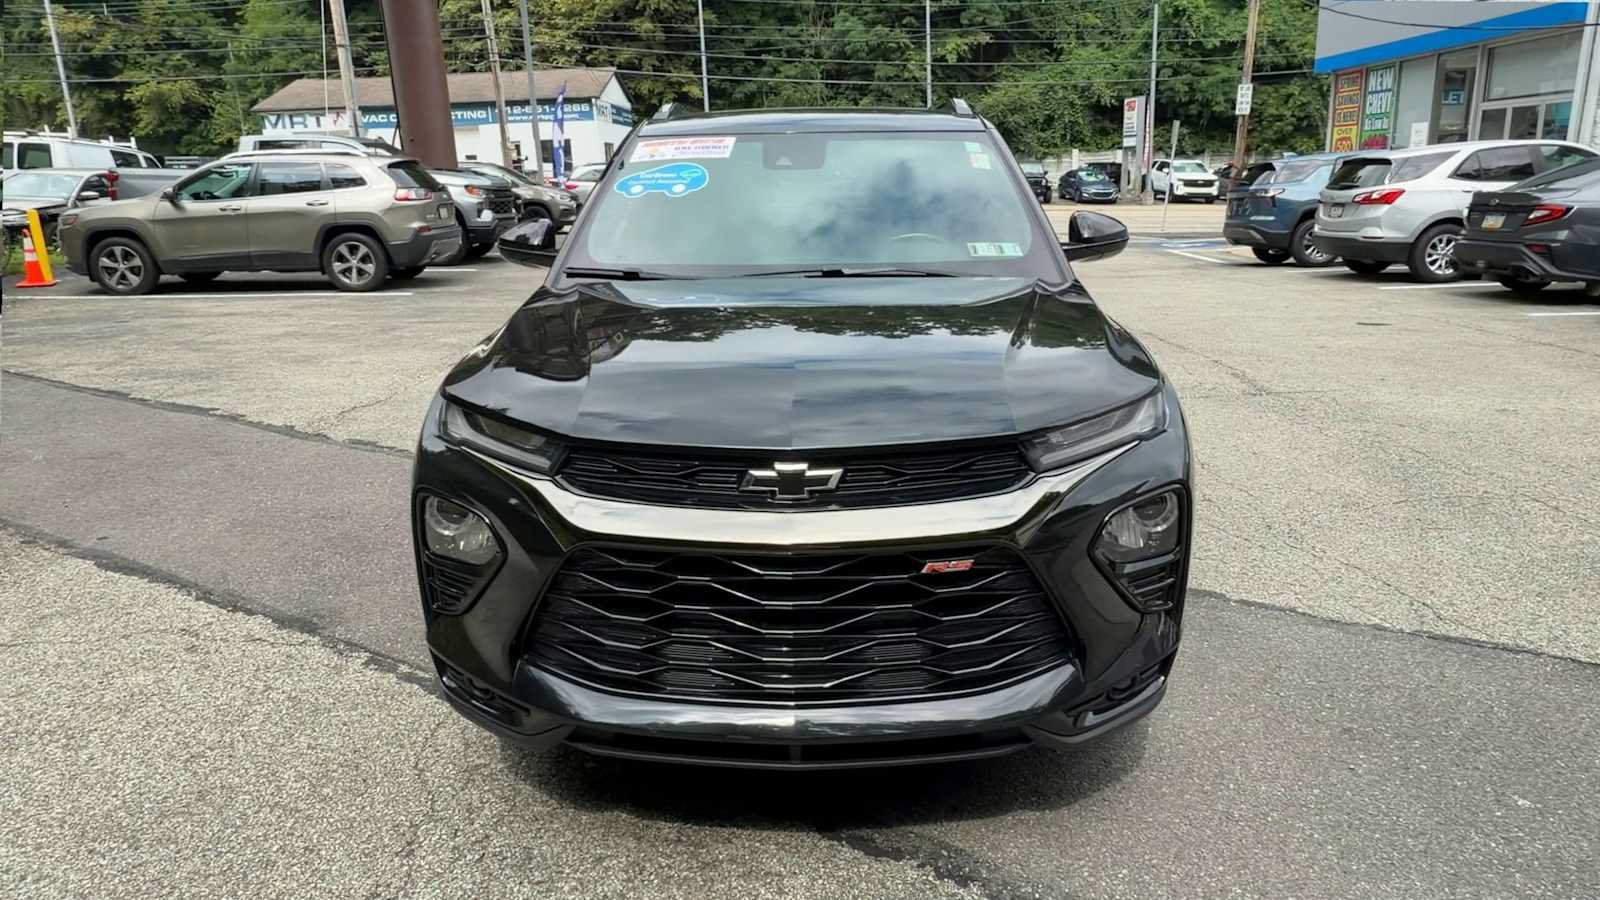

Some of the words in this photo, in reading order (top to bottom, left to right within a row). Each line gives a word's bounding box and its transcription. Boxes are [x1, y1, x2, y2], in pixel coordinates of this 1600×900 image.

[1368, 69, 1393, 90] NEW
[1366, 91, 1392, 114] CHEVY
[361, 113, 388, 124] VAC
[451, 109, 487, 121] TING
[921, 560, 975, 573] RS
